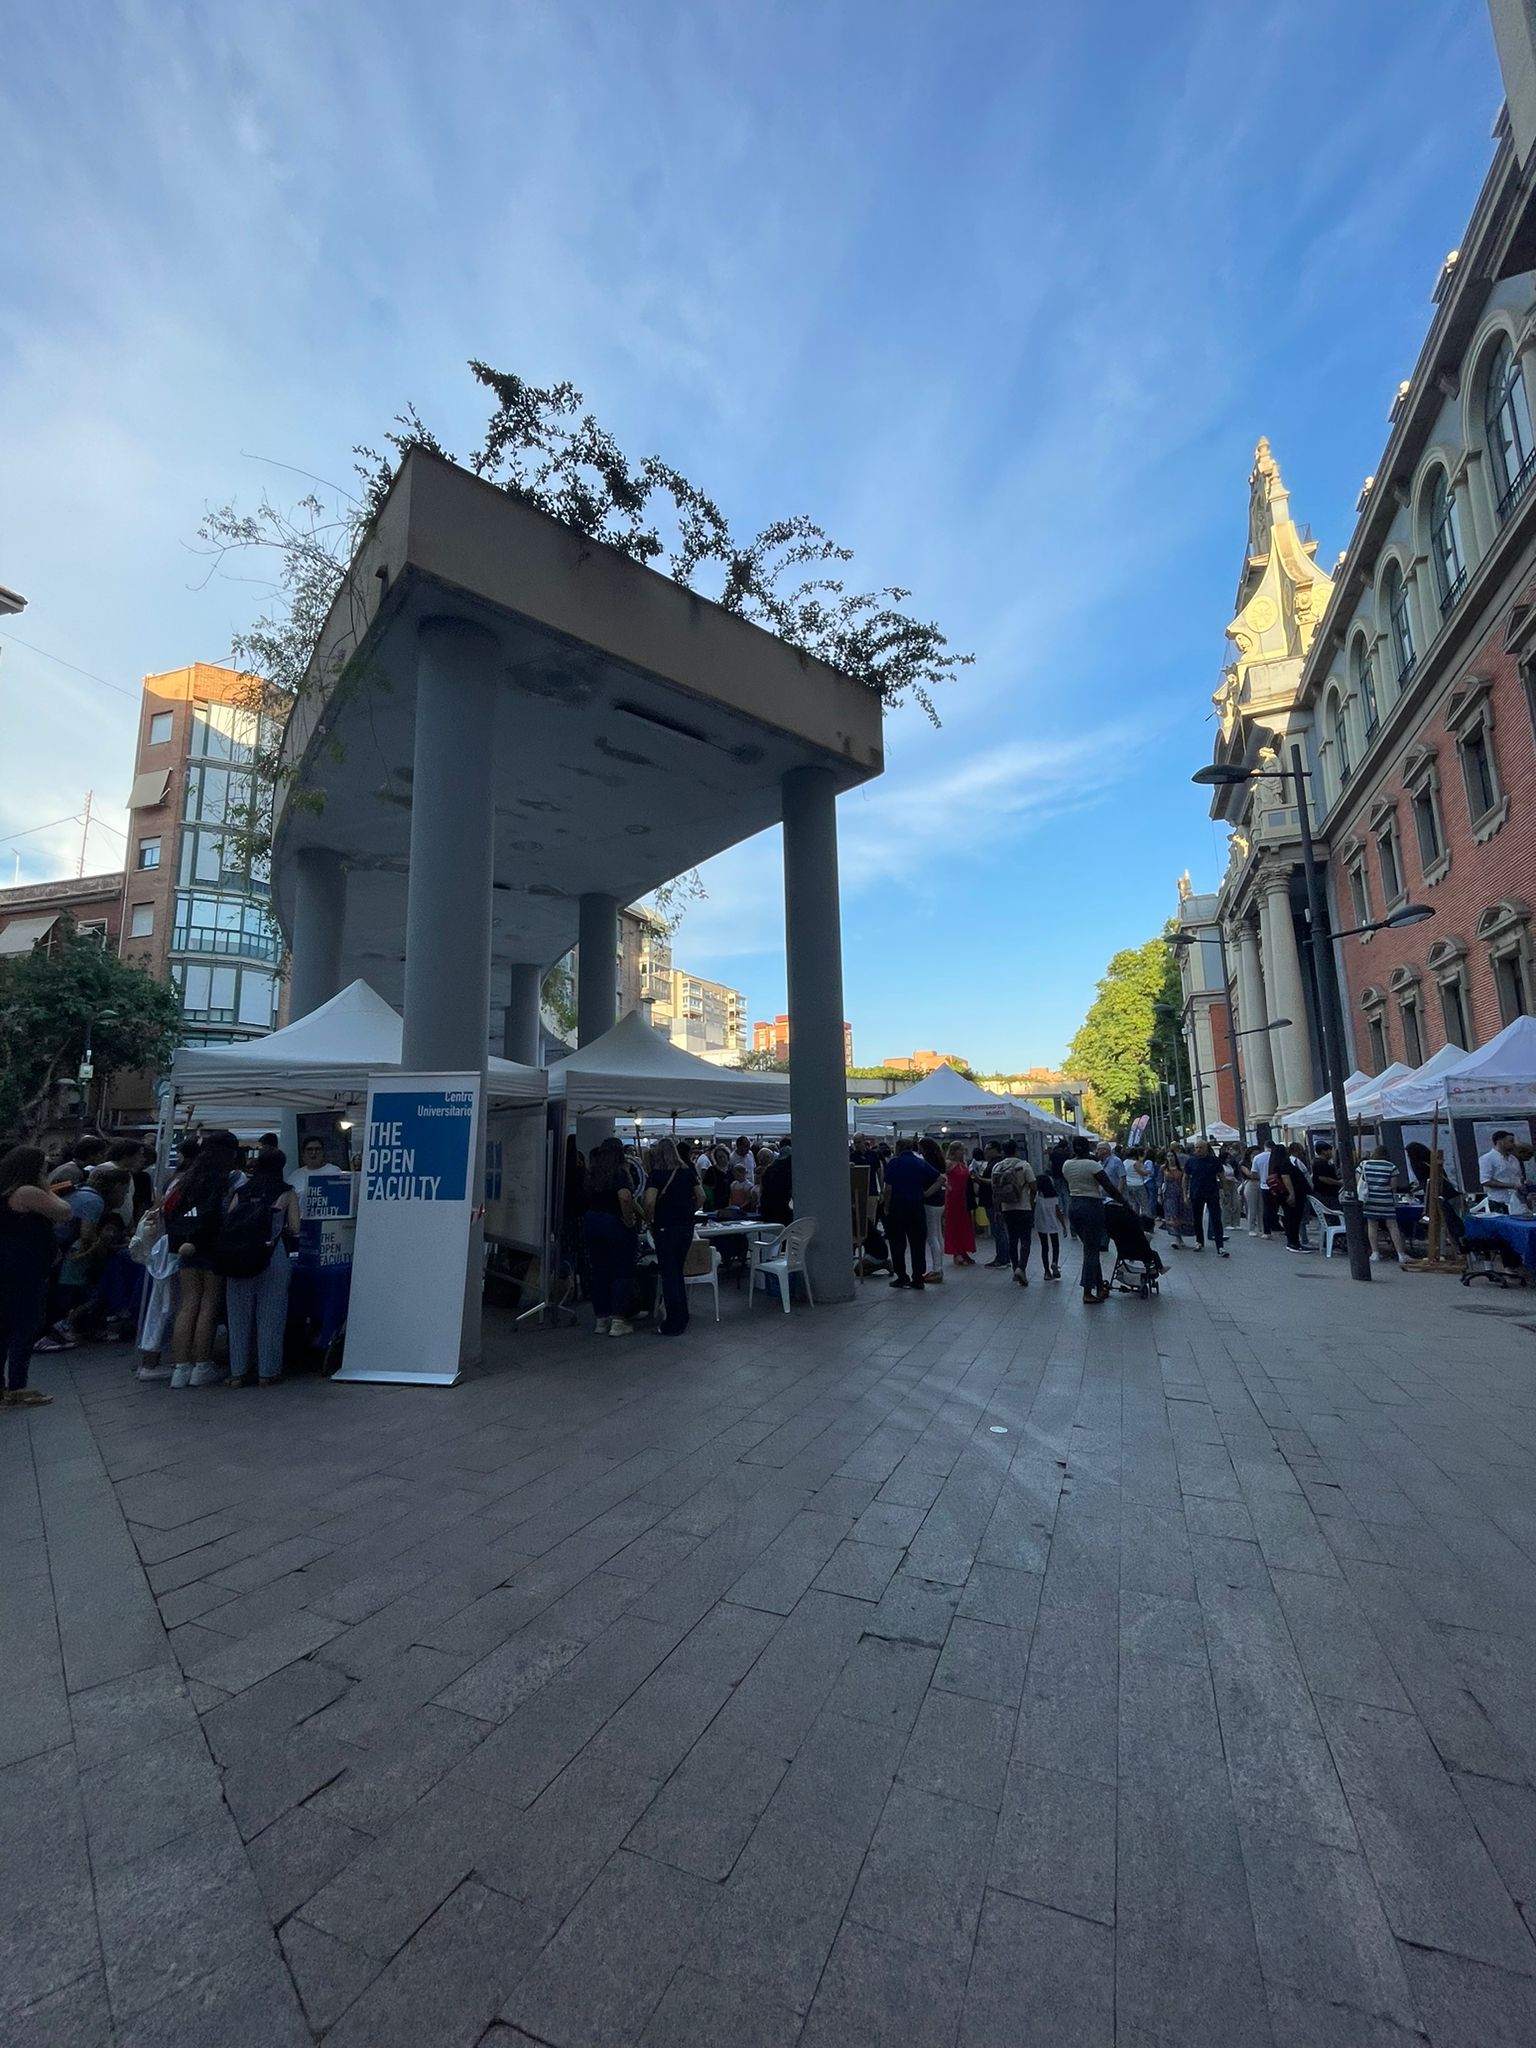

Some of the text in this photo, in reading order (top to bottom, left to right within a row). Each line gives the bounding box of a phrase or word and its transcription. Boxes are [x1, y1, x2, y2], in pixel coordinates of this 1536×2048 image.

[444, 1091, 473, 1102] Centro
[417, 1105, 473, 1117] Universitario
[370, 1122, 403, 1146] THE
[367, 1148, 415, 1174] OPEN
[307, 1186, 323, 1197] THE
[366, 1176, 441, 1201] FACULTY
[306, 1196, 328, 1207] OPEN
[305, 1206, 340, 1216] FACULTY
[320, 1232, 336, 1243] THE
[319, 1243, 341, 1254] OPEN
